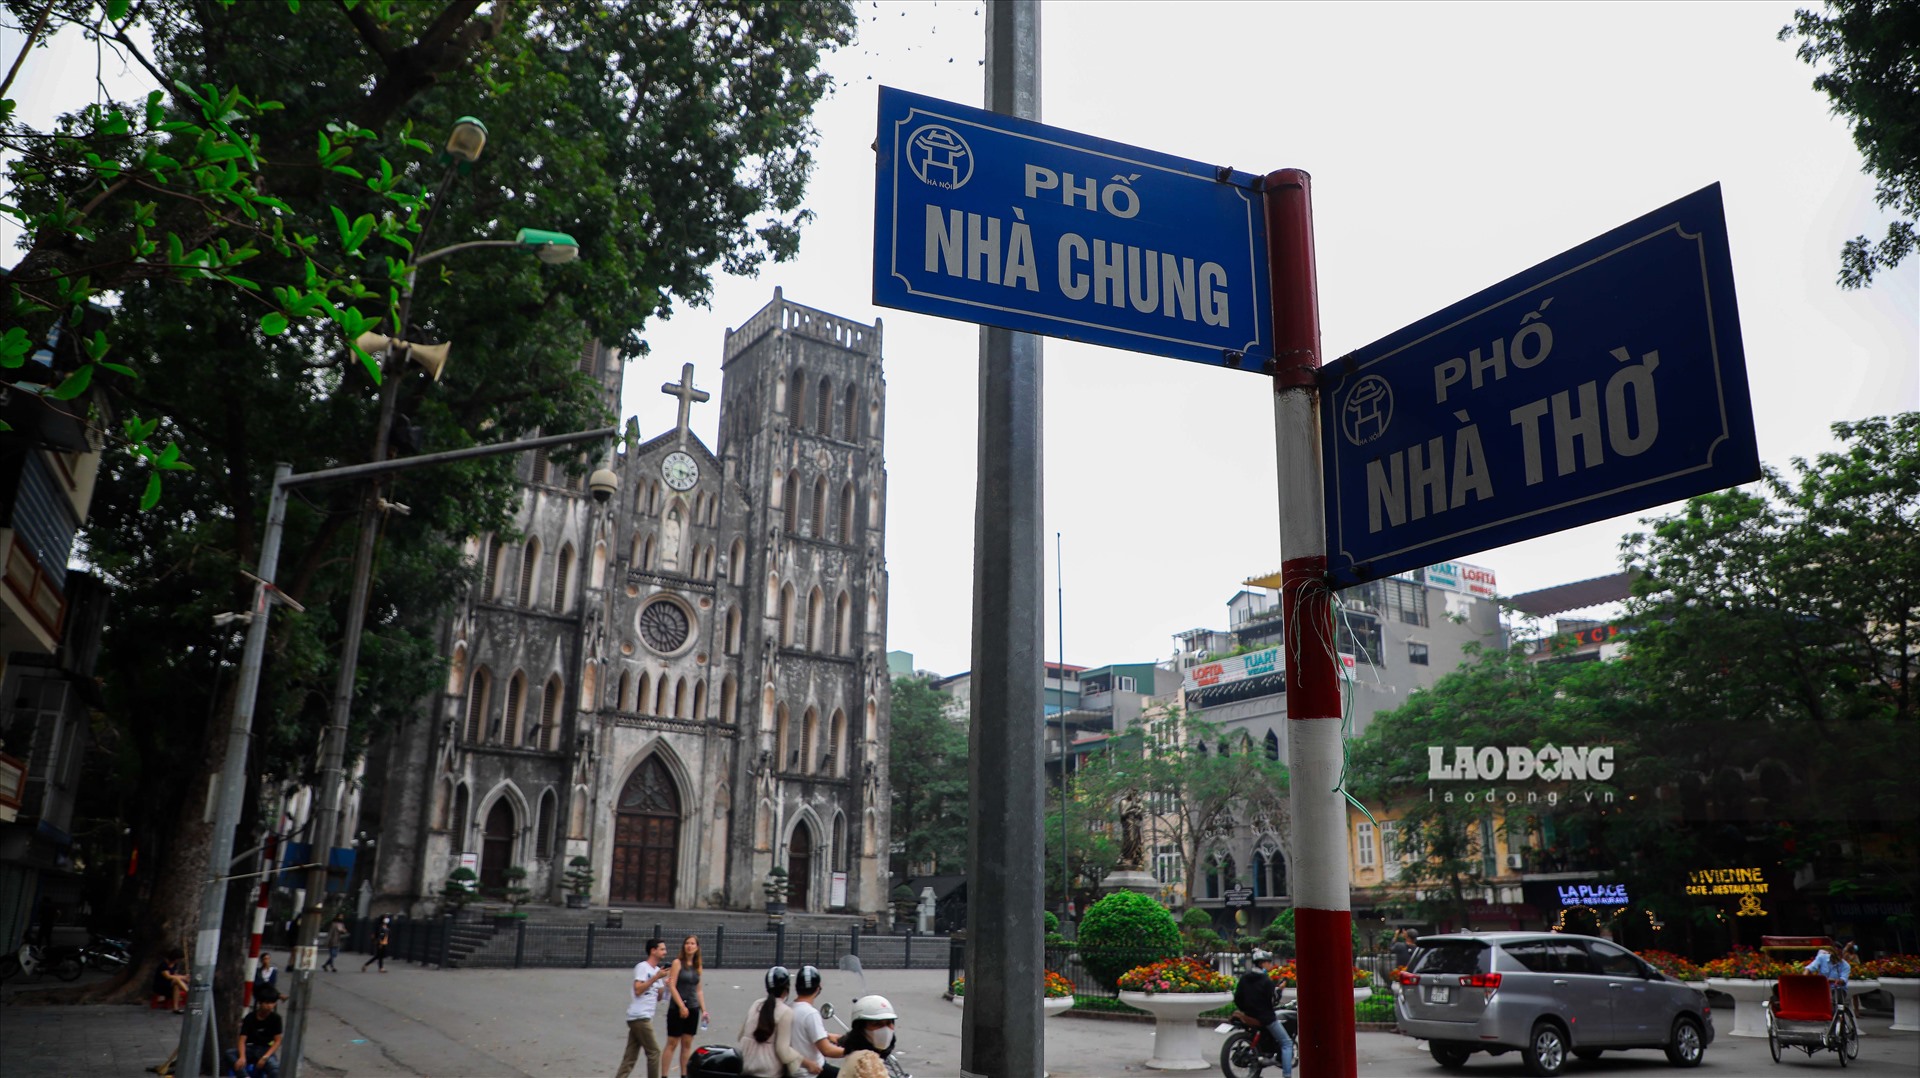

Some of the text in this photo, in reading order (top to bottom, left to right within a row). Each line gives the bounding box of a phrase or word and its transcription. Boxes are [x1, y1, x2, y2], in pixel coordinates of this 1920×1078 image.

[1025, 164, 1141, 219] PHỐ
[925, 204, 1230, 328] NHÀ CHUNG
[1434, 297, 1554, 404] PHỐ
[1366, 346, 1660, 534] NHÀ THỜ
[1192, 663, 1224, 680] LOFITA
[1243, 648, 1278, 668] TUART
[1557, 884, 1627, 898] LA PLACE
[1689, 867, 1764, 883] VIVIENNE
